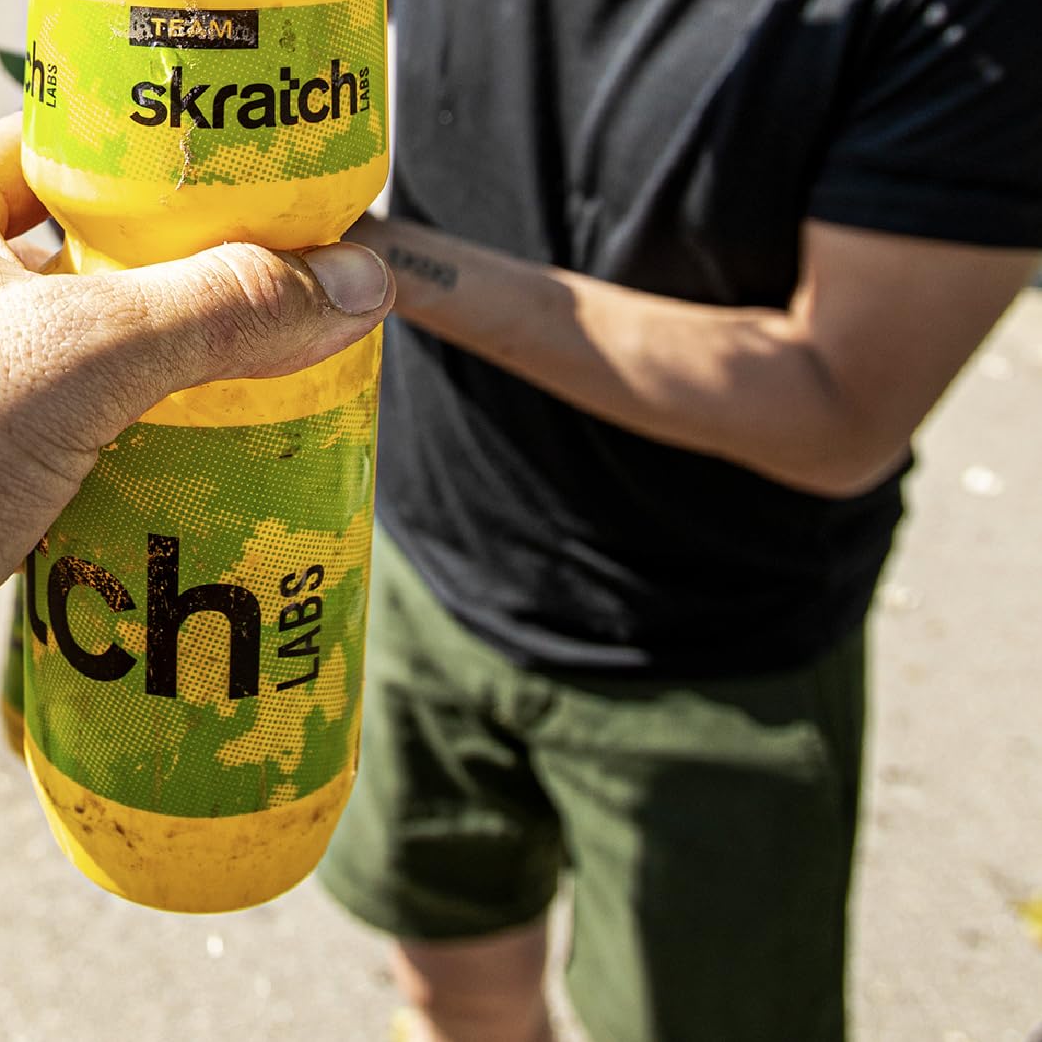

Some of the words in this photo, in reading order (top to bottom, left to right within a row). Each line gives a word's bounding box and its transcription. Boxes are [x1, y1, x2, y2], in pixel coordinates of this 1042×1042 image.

[150, 17, 233, 39] TEAM
[46, 64, 57, 108] LABS
[130, 59, 358, 129] skratch
[360, 66, 370, 111] LABS
[276, 564, 325, 692] LABS
